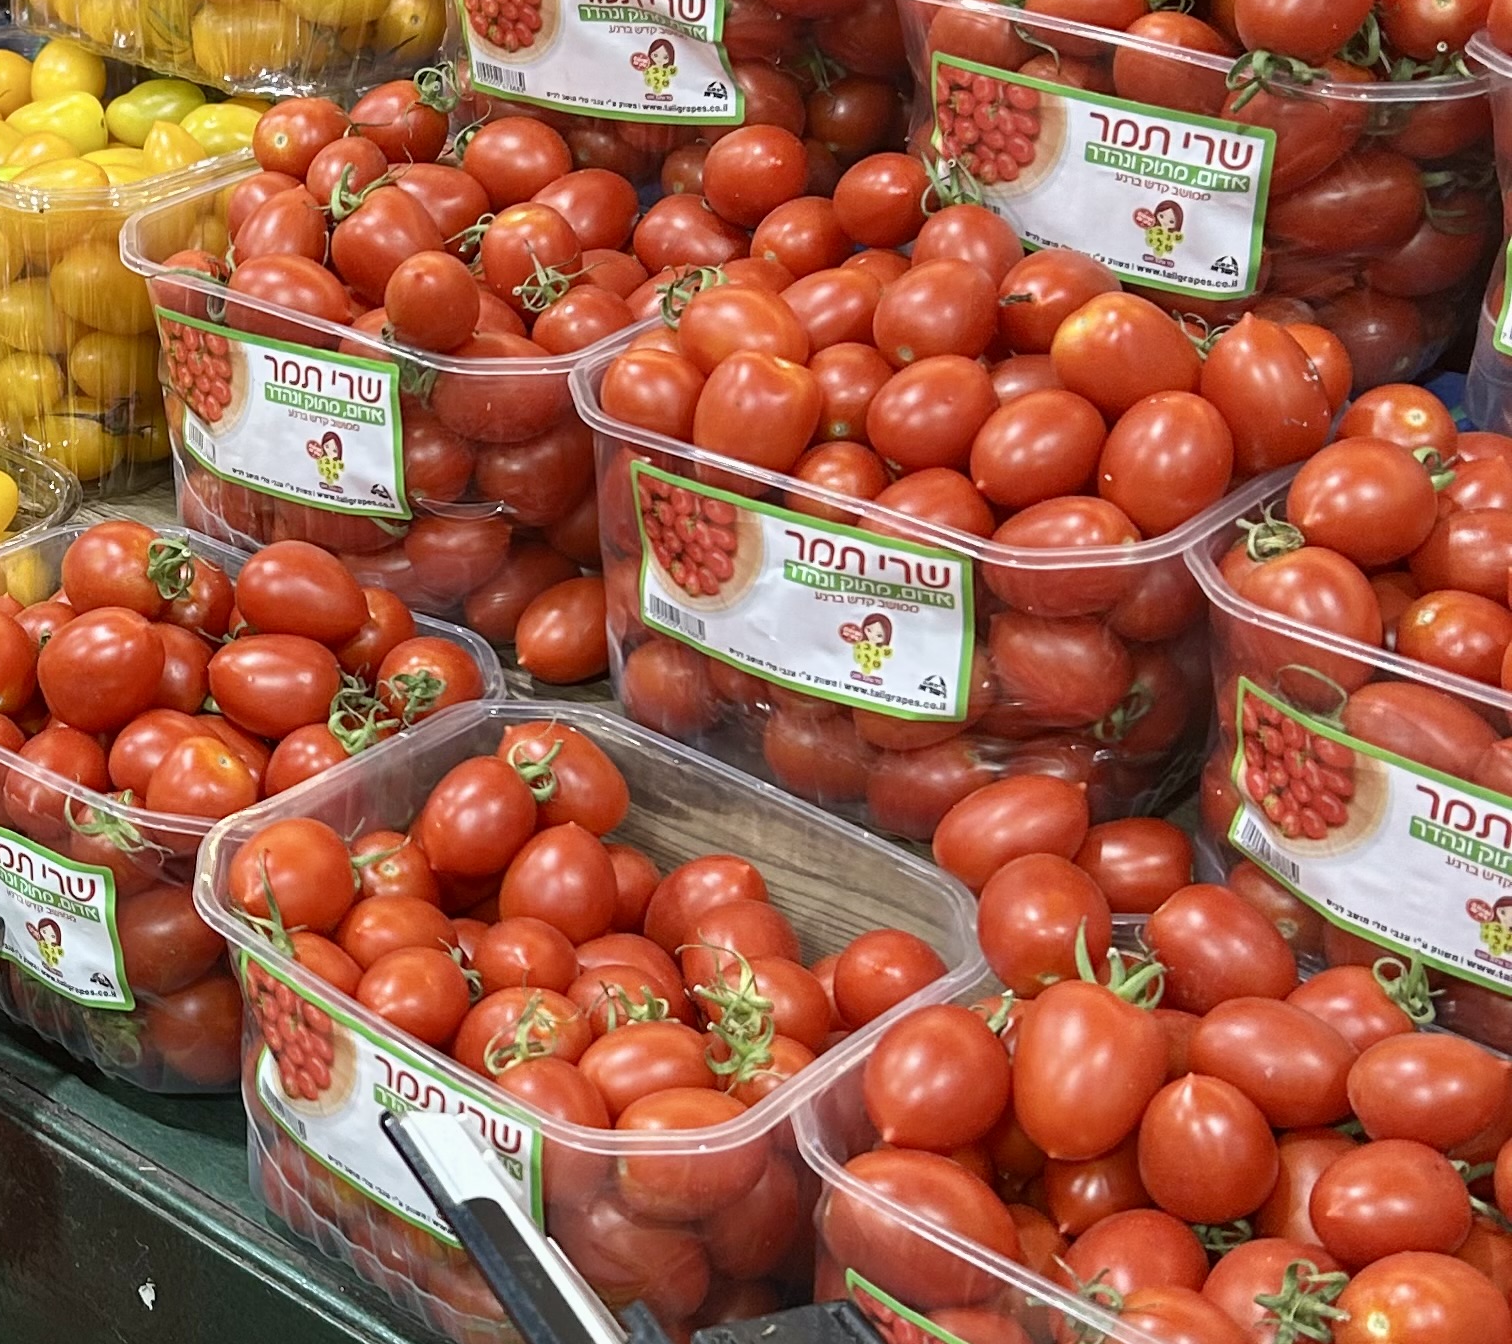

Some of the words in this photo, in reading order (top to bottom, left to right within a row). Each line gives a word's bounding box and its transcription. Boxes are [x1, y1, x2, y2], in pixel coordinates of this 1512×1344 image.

[581, 7, 624, 20] ונהדר
[1090, 112, 1170, 155] תמר
[1087, 144, 1136, 169] ונהדר
[1184, 130, 1253, 169] שרי
[1140, 159, 1187, 178] מתוק
[1191, 173, 1248, 190] אדום,
[264, 355, 321, 391] תמר
[266, 384, 302, 404] ונהדר
[332, 370, 381, 403] שרי
[305, 393, 340, 414] מתוק
[343, 403, 383, 424] אדום,
[785, 530, 866, 575] תמר
[786, 562, 834, 588] ונהדר
[879, 554, 949, 588] שרי
[841, 575, 891, 596] מתוק
[897, 586, 952, 605] אדום,
[1417, 785, 1512, 849] תמר
[1413, 820, 1472, 856] ונהדר
[20, 877, 54, 901] מתוק
[42, 864, 95, 901] שרי
[56, 895, 98, 920] אדום,
[375, 1054, 445, 1113] תמר
